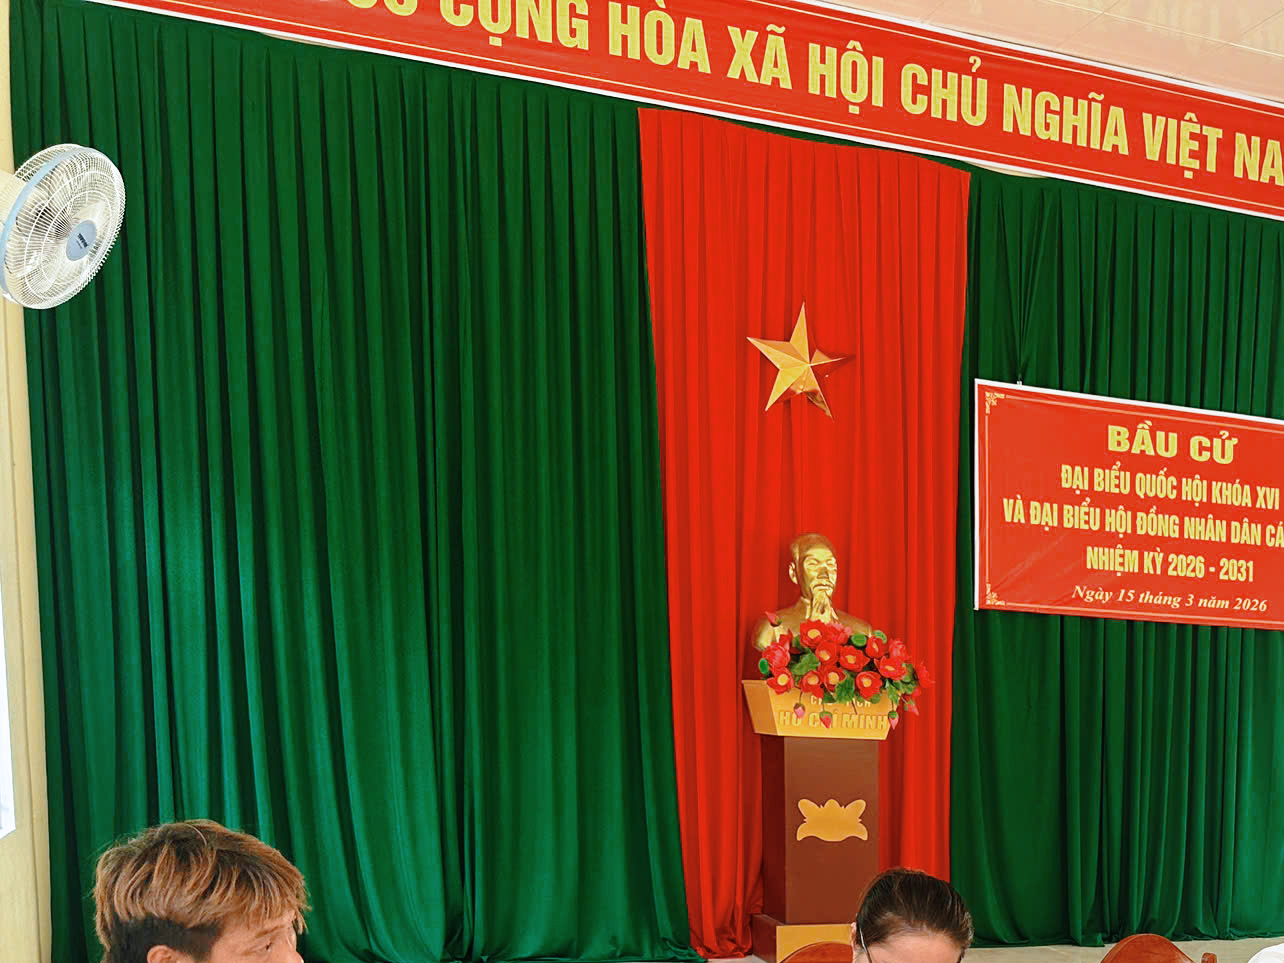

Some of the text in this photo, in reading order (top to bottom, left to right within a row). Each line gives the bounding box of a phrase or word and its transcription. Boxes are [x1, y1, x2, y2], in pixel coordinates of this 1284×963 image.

[608, 0, 712, 75] HÒA
[726, 23, 793, 90] XÃ
[807, 39, 884, 115] HỘI
[900, 55, 988, 127] CHỦ
[1002, 83, 1129, 156] NGHĨA
[1142, 111, 1223, 180] VIỆT
[1107, 419, 1239, 465] BẦU CỬ
[1060, 460, 1281, 511] ĐẠI BIỂU QUỐC HỘI KHÓA XVI
[1002, 493, 1026, 524] VÀ
[1029, 500, 1059, 532] ĐẠI
[1063, 496, 1101, 531] BIỂU
[1104, 504, 1132, 539] HỘI
[1135, 505, 1180, 539] ĐỒNG
[1183, 513, 1227, 543] NHÂN
[1230, 517, 1262, 546] DÂN
[1086, 543, 1139, 577] NHIỆM
[1143, 546, 1165, 575] KỲ
[1167, 553, 1205, 579] 2026
[1218, 557, 1254, 583] 2031
[1071, 585, 1268, 613] Ngày 15 tháng 3 năm 2026
[842, 713, 889, 730] MINH
